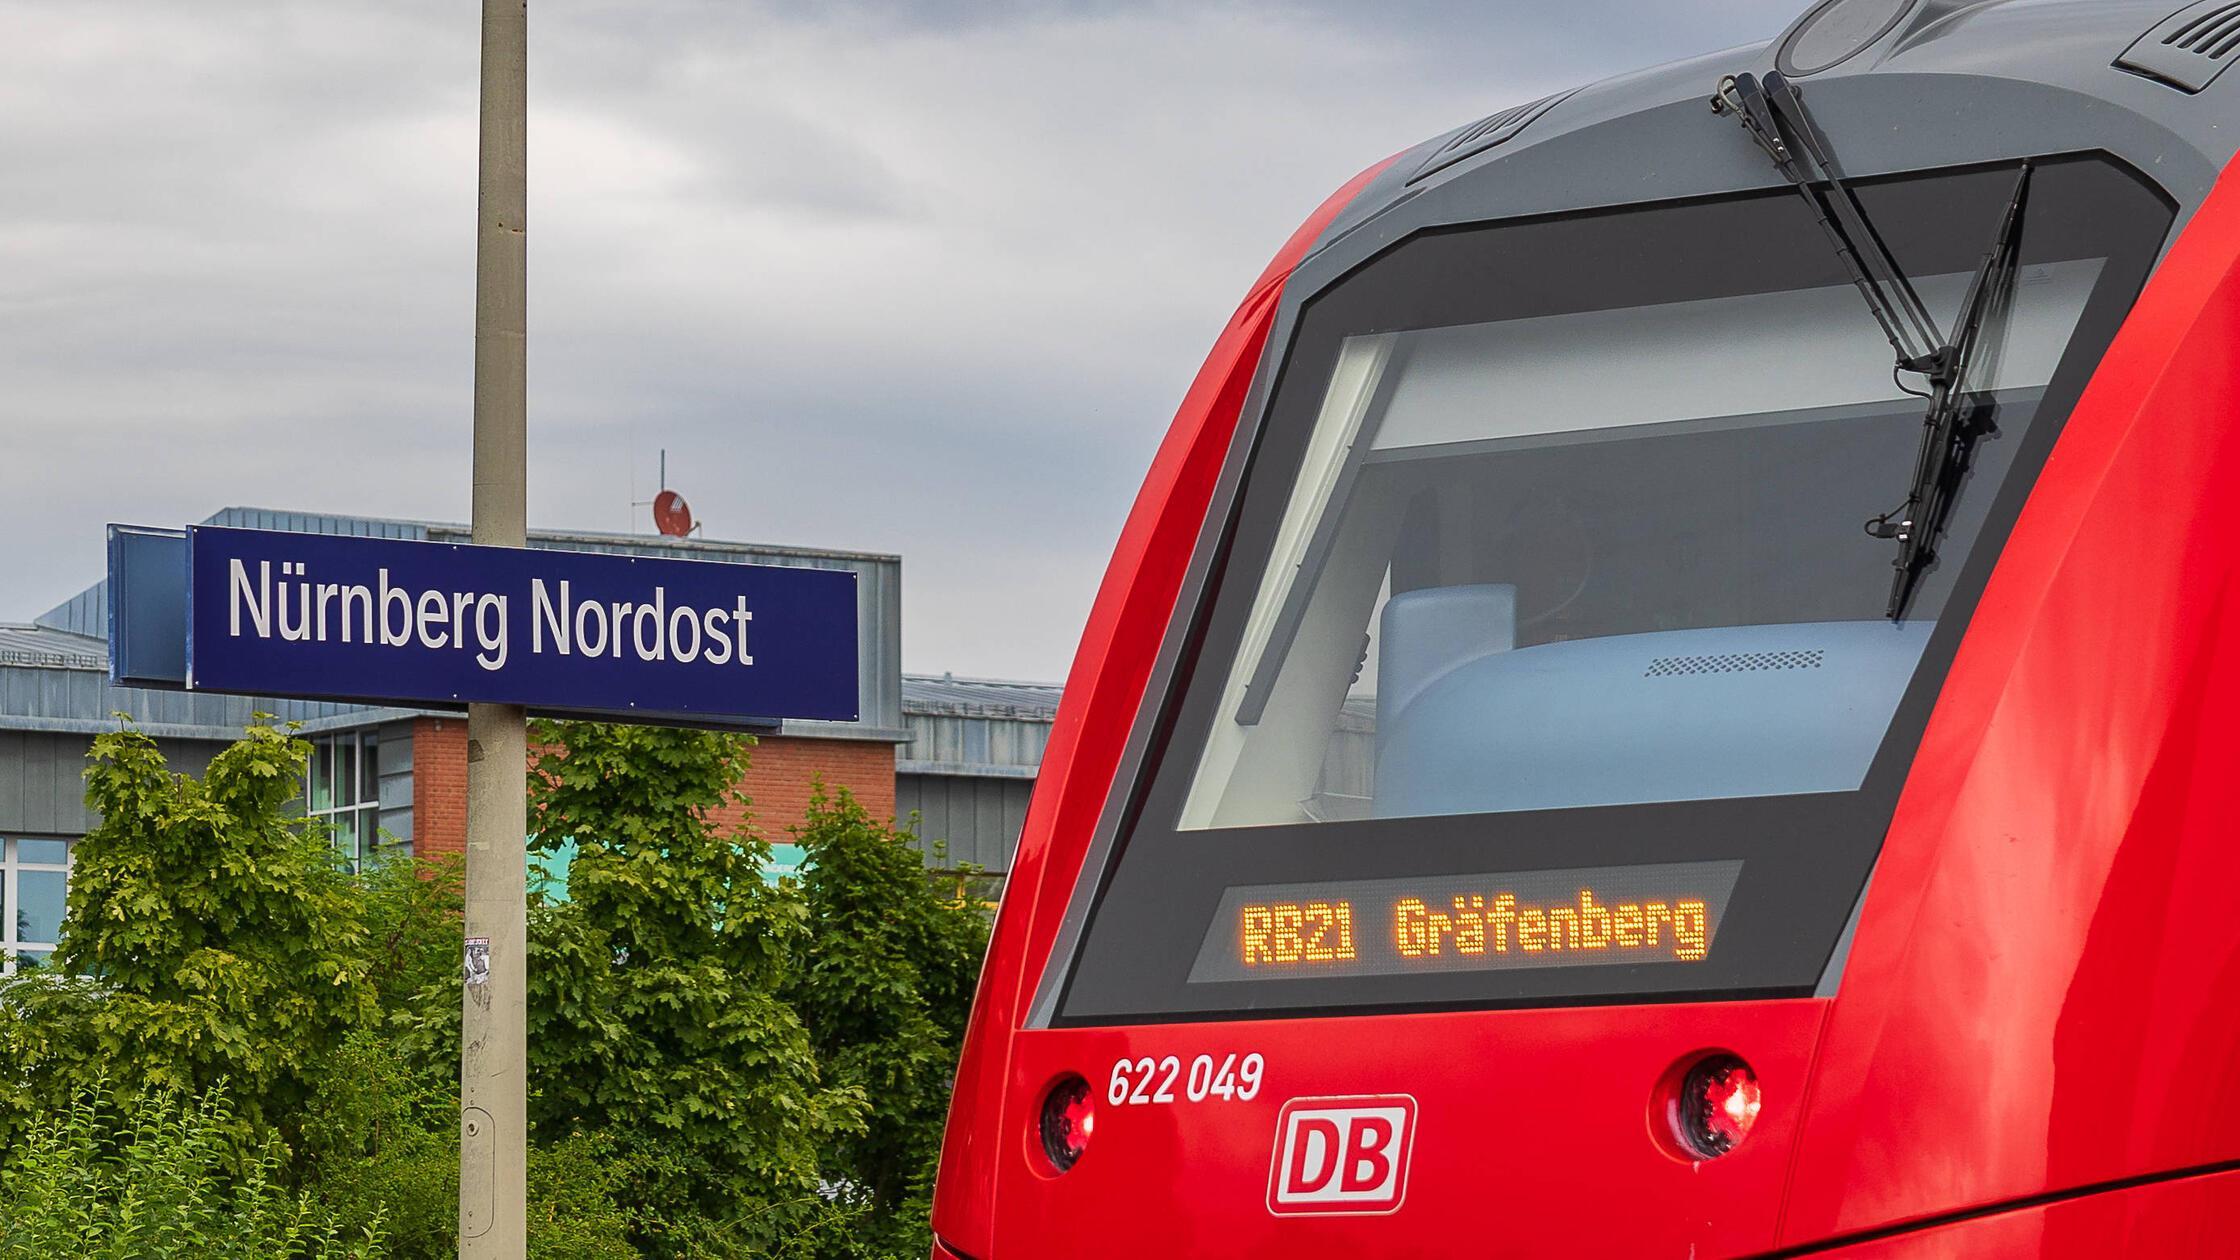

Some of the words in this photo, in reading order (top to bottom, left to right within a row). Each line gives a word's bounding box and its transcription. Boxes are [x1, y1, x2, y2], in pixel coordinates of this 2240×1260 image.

[230, 558, 508, 671] Nürnberg
[531, 578, 755, 667] Nordost
[1240, 900, 1357, 966] RB21
[1393, 889, 1709, 962] Gräfenberg
[1109, 1054, 1180, 1106] 622
[1186, 1053, 1264, 1102] 049
[1287, 1116, 1394, 1194] DB
